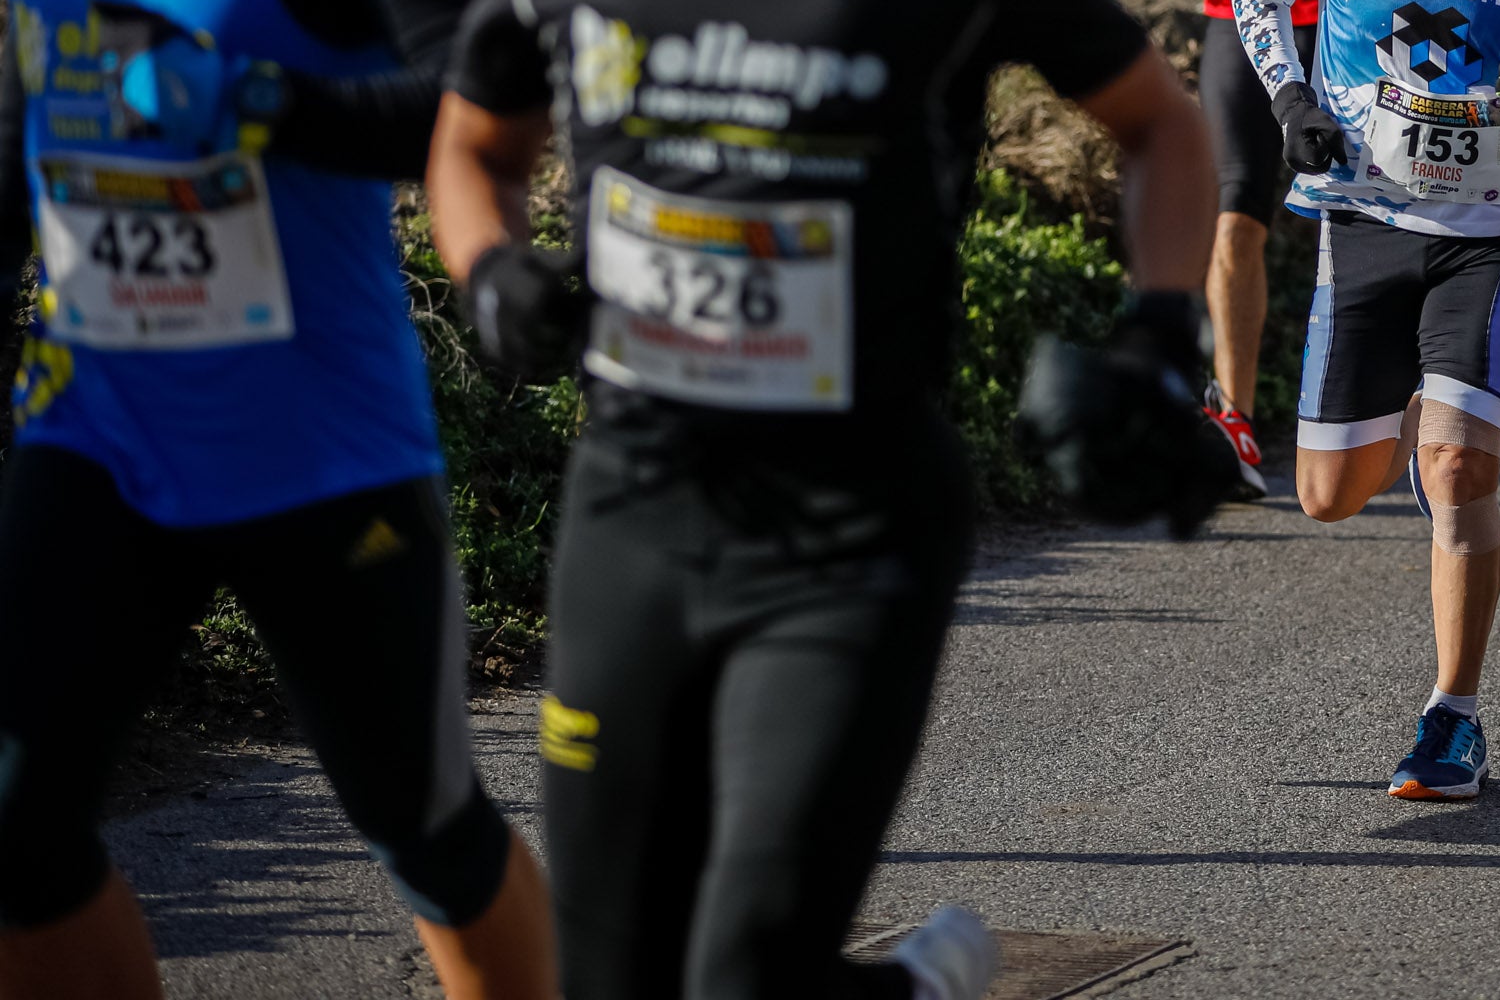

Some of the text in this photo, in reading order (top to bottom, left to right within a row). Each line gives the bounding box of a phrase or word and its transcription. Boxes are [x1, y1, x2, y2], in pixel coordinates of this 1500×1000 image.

[1411, 95, 1464, 111] CARRERA
[1411, 103, 1464, 117] POPULAR
[1407, 110, 1438, 122] Secaderos
[1402, 123, 1479, 166] 153
[1412, 161, 1463, 182] FRANCIS
[1430, 183, 1459, 193] olimpo
[90, 210, 217, 278] 423
[648, 251, 780, 329] 326
